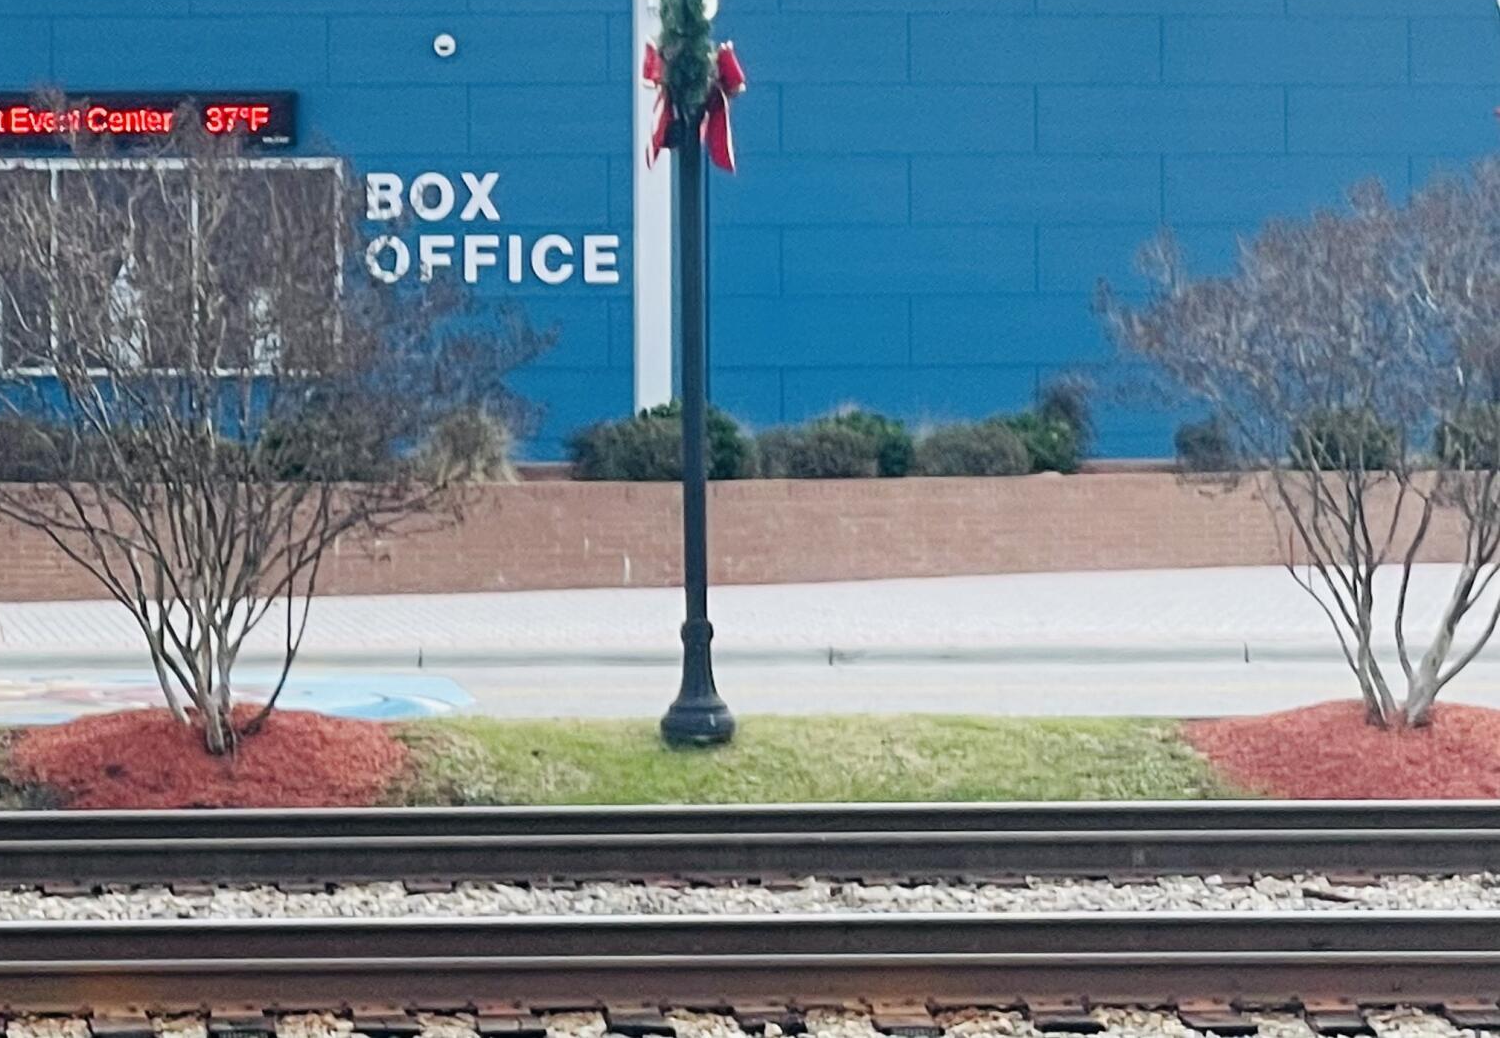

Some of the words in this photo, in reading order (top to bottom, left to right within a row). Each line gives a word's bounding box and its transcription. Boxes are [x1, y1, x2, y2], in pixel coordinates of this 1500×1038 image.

[87, 107, 174, 133] Center
[365, 171, 501, 222] BOX
[364, 233, 621, 285] OFFICE
